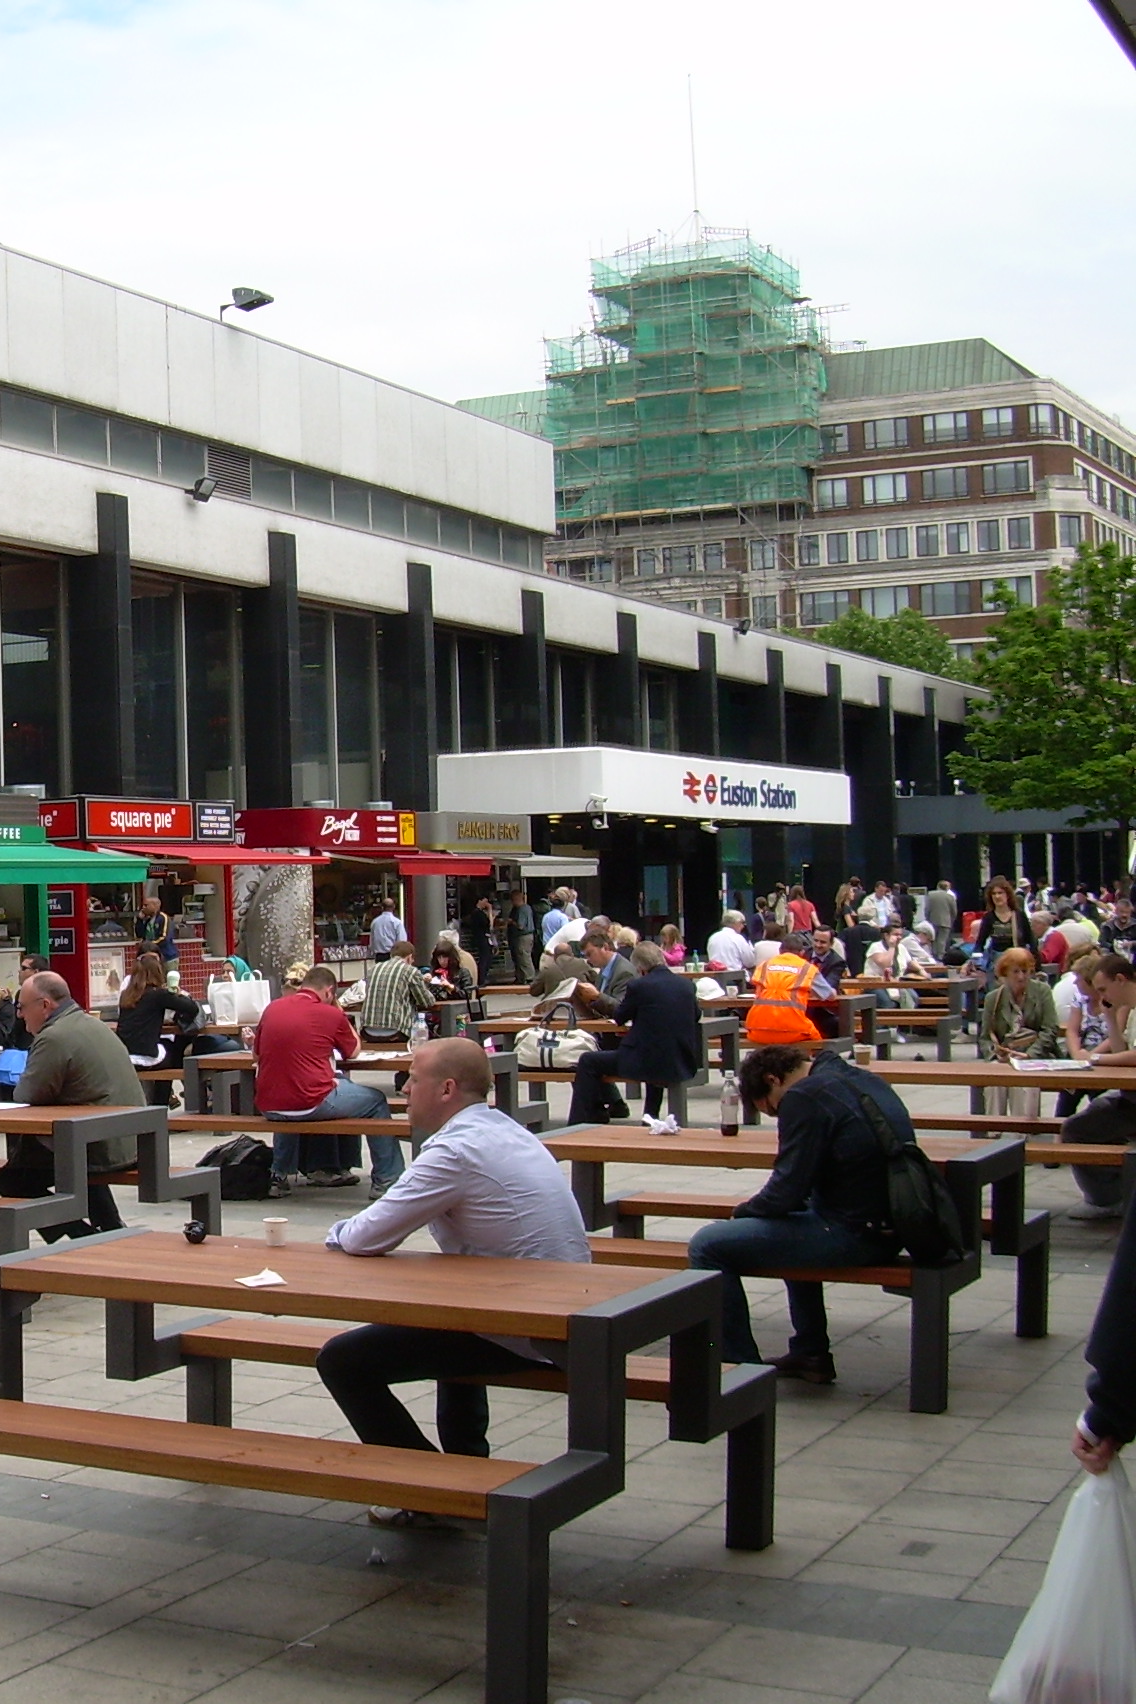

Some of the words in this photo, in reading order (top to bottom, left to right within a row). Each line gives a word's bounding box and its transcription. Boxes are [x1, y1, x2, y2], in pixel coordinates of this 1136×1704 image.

[720, 776, 758, 807] Euston
[760, 779, 797, 809] Station
[110, 809, 151, 832] square
[154, 812, 172, 833] pie
[320, 812, 359, 844] Bagel
